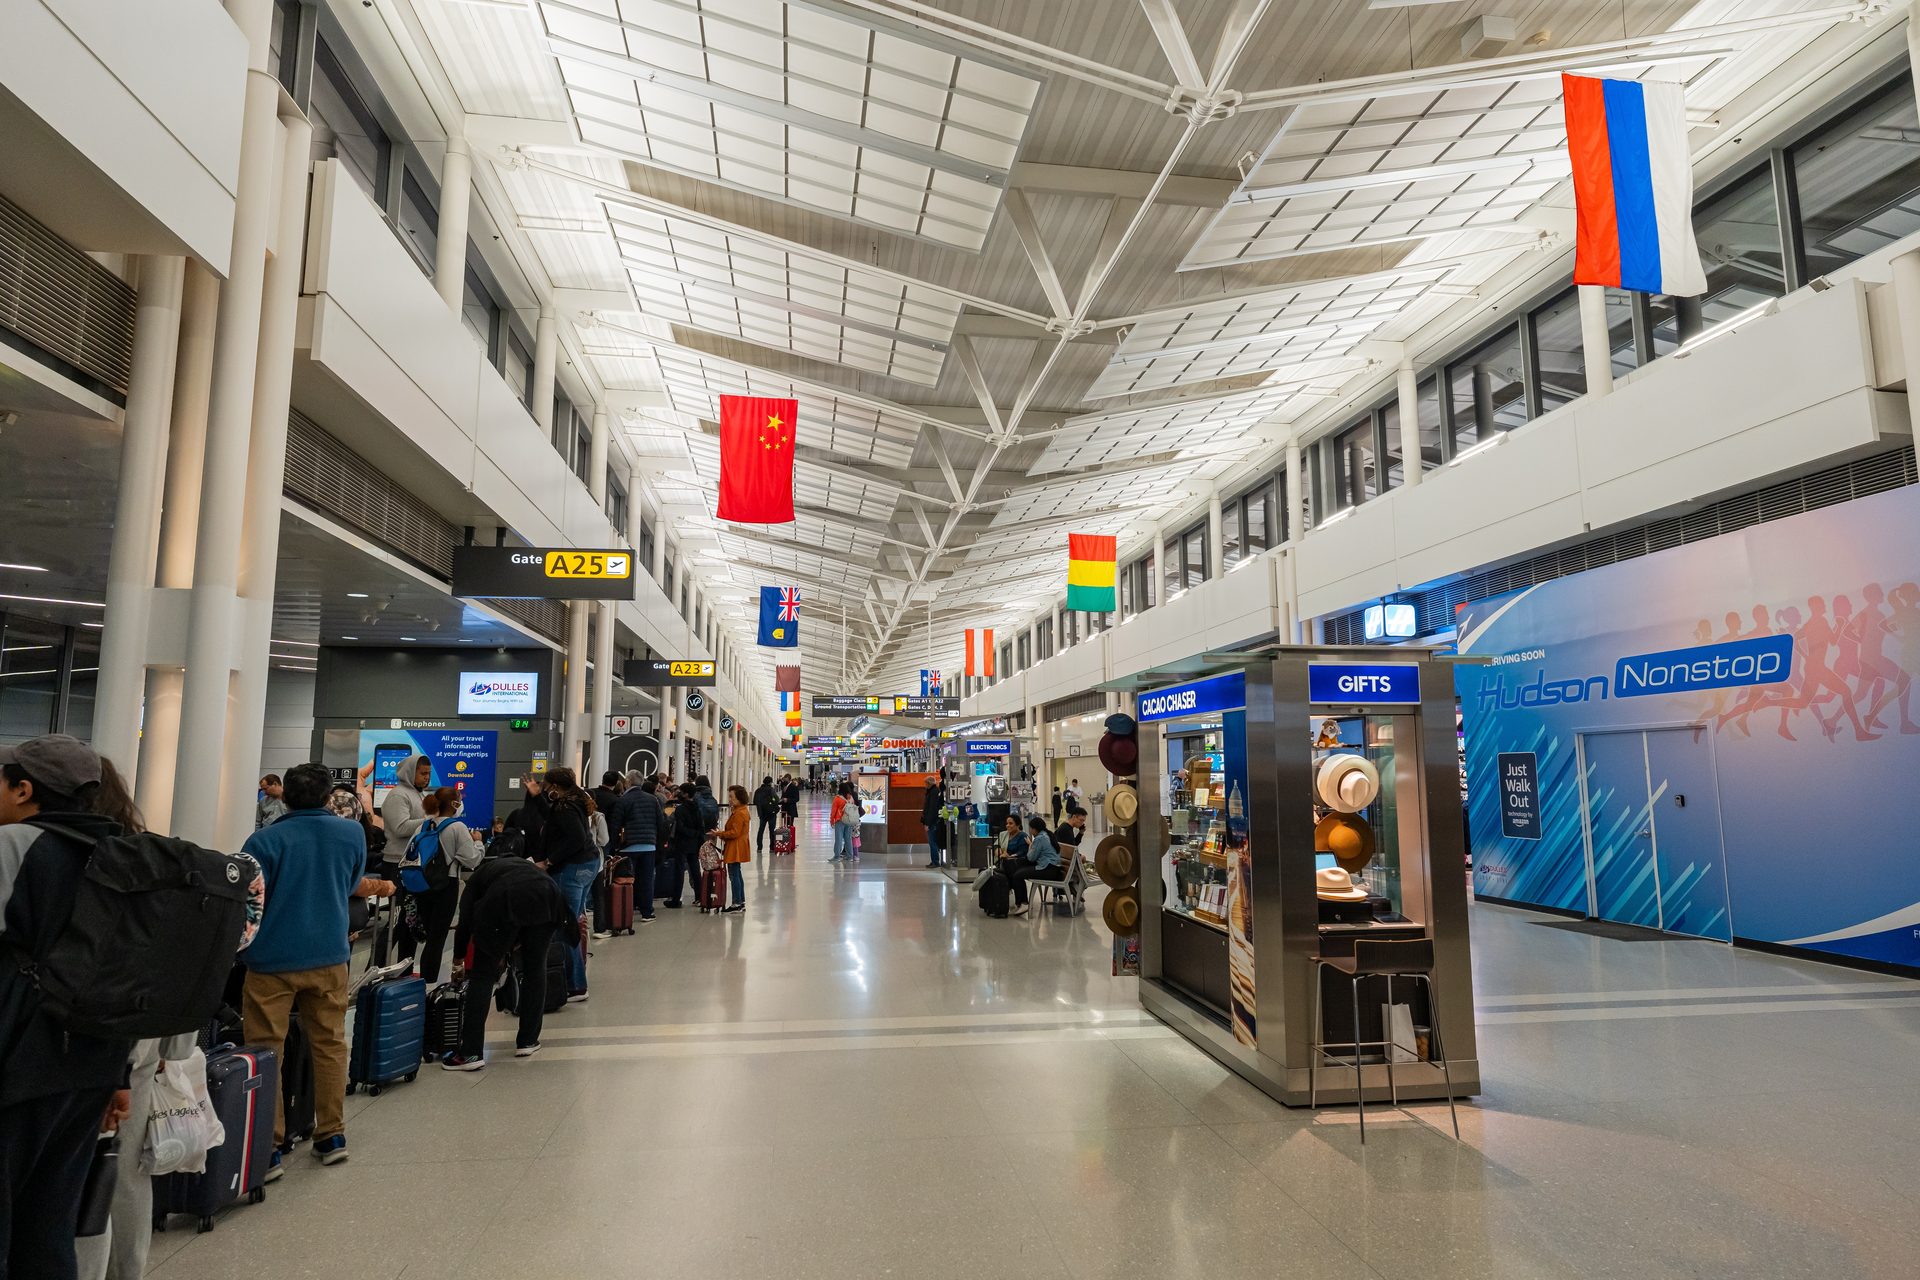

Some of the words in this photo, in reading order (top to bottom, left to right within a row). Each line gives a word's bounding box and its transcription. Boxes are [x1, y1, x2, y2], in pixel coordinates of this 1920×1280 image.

[511, 553, 543, 564] Gate
[550, 555, 603, 575] A25
[1521, 649, 1545, 661] SOON
[673, 664, 700, 674] A23
[492, 683, 529, 691] DULLES
[1338, 675, 1392, 693] GIFTS
[1476, 669, 1609, 711] Hudson
[1622, 651, 1781, 690] Nonstop
[1142, 696, 1166, 716] CACAO
[1167, 690, 1196, 712] CHASER
[402, 720, 446, 729] Telephones
[1507, 763, 1527, 776] Just
[1505, 779, 1531, 793] Walk
[1509, 794, 1529, 808] Out
